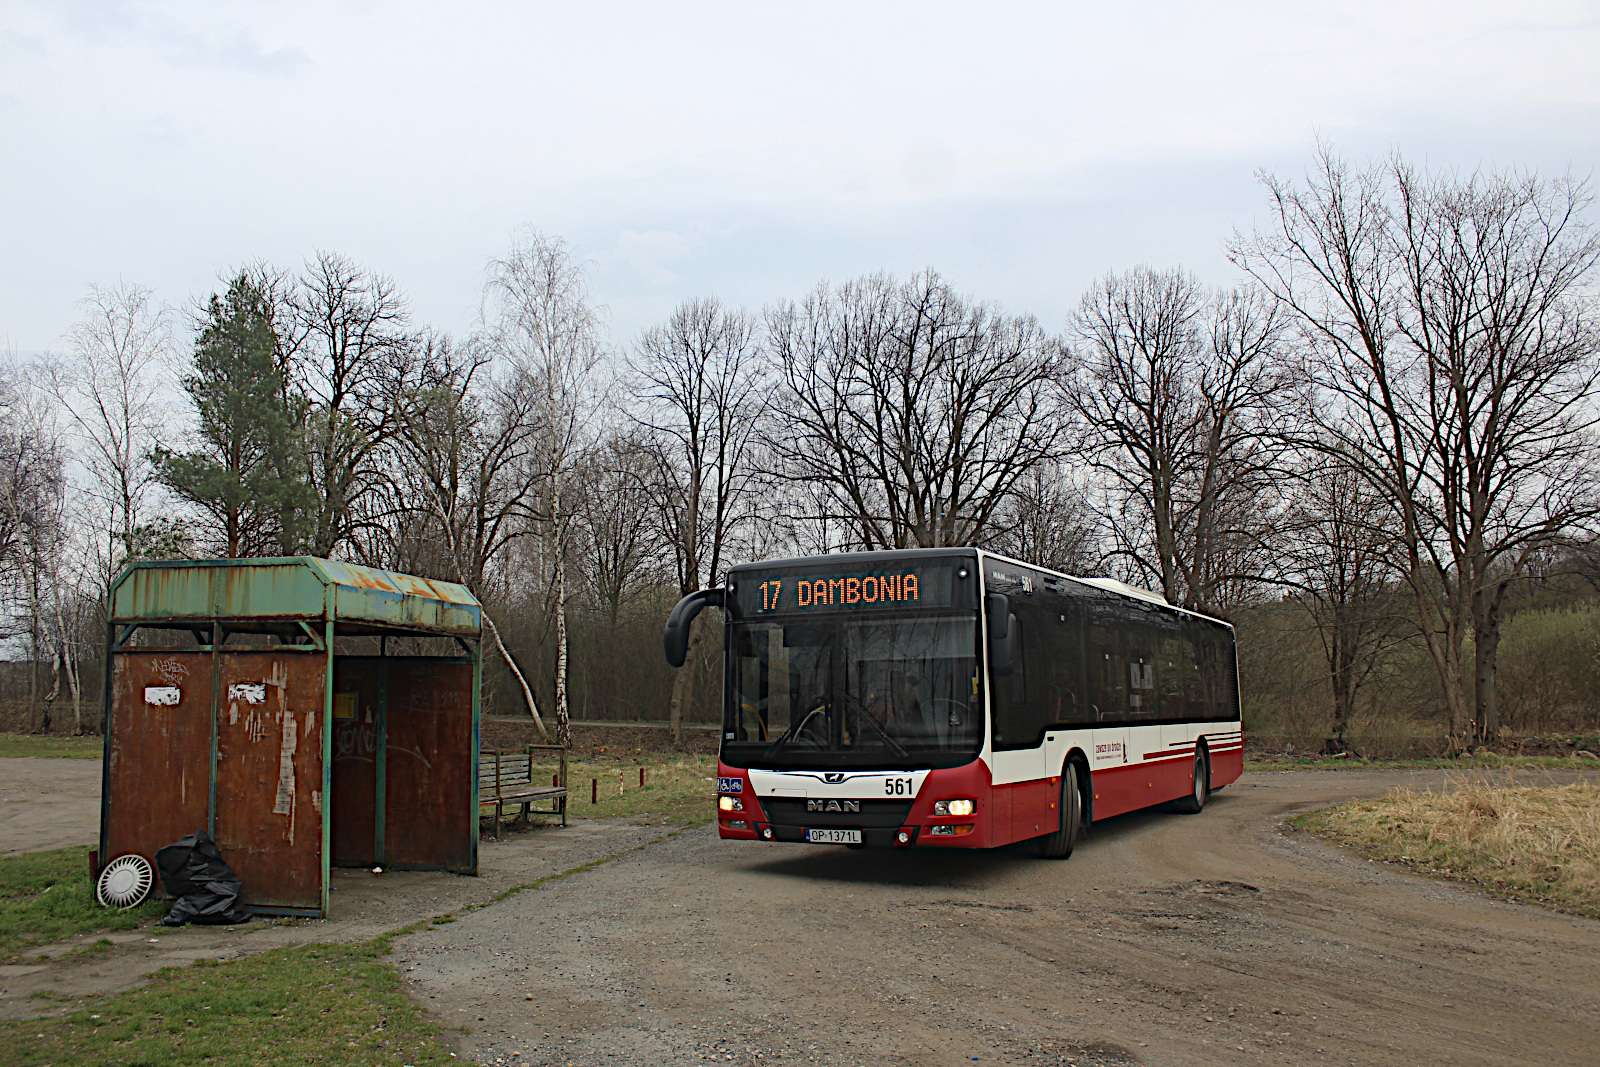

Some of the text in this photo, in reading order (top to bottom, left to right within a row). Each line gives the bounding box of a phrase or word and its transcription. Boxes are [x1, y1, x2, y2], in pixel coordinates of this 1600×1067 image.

[758, 573, 919, 610] 17 DAMBONIA
[1021, 575, 1033, 593] 561
[885, 778, 913, 795] 561
[807, 800, 860, 812] MAN
[811, 830, 859, 842] OP 1371L
